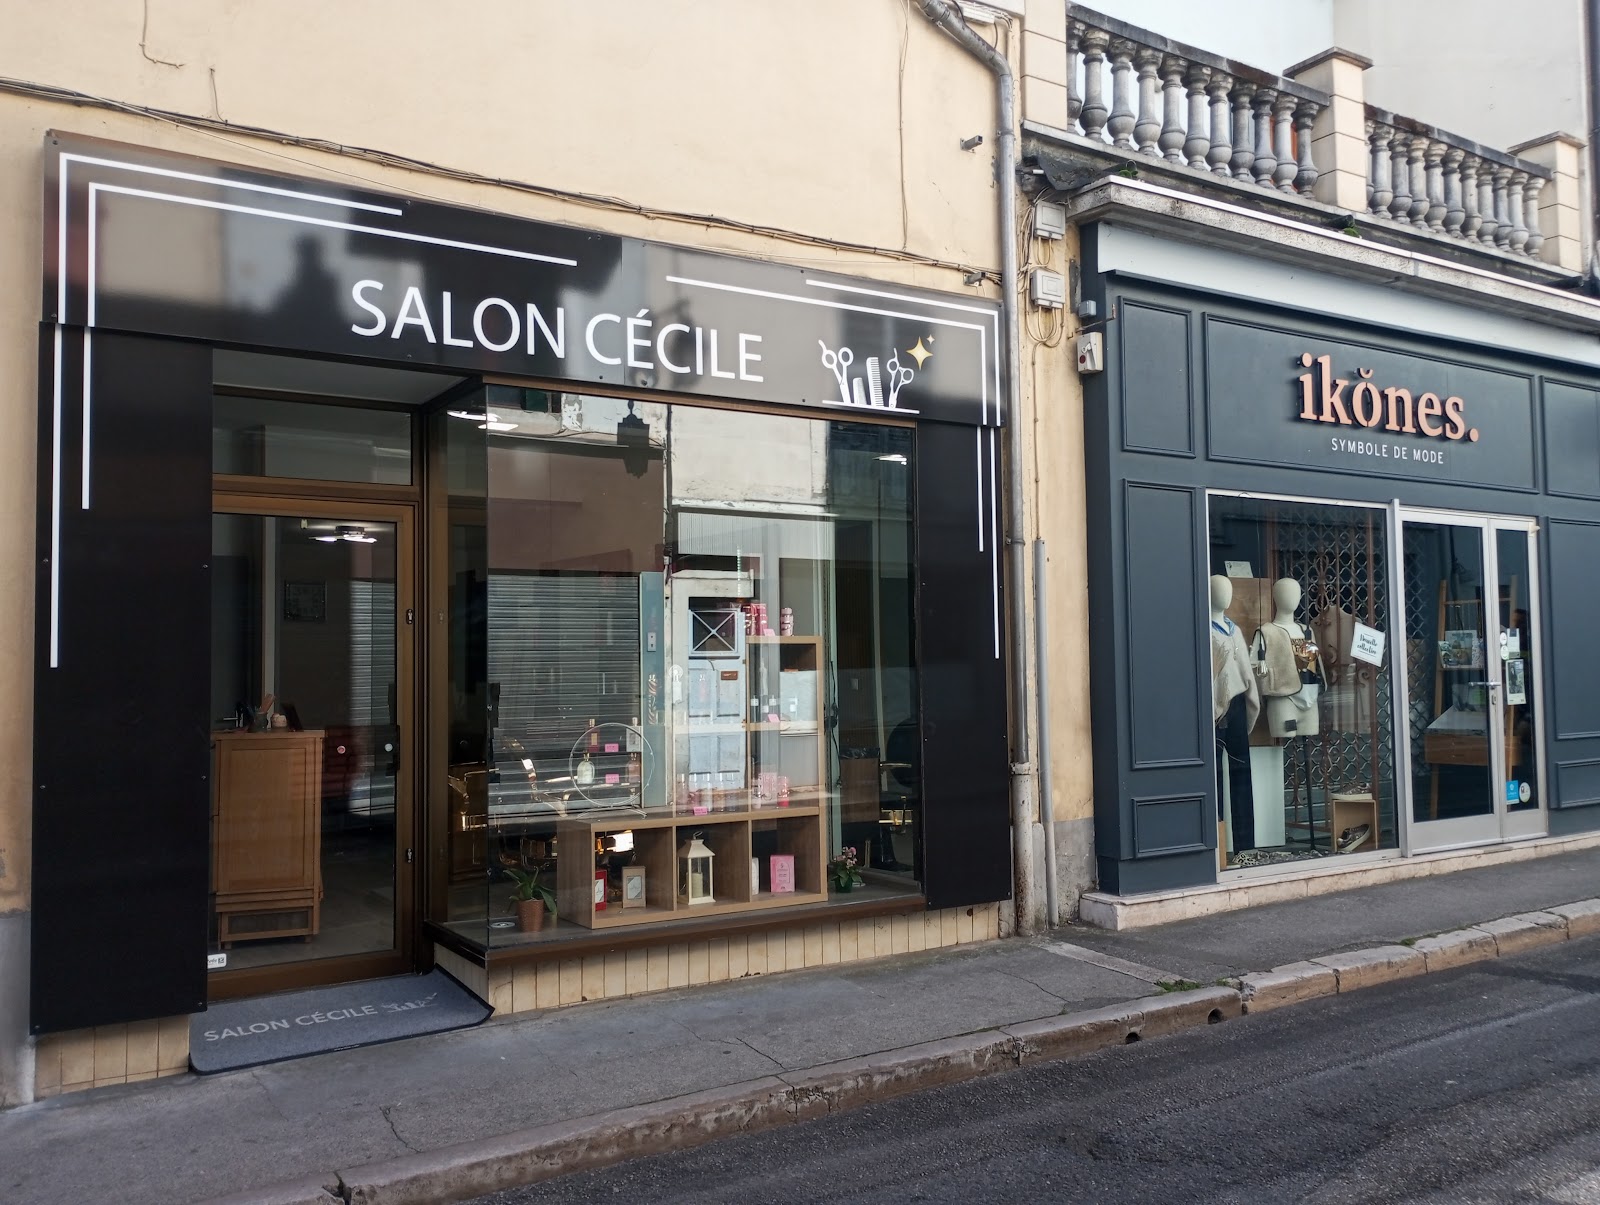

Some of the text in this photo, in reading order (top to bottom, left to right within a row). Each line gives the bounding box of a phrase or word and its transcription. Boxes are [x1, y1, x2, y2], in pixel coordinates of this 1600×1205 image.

[350, 279, 764, 384] SALON CÉCILE
[1331, 437, 1444, 464] SYMBOLE DE MODE
[203, 1004, 378, 1042] SALON CÉCILE
